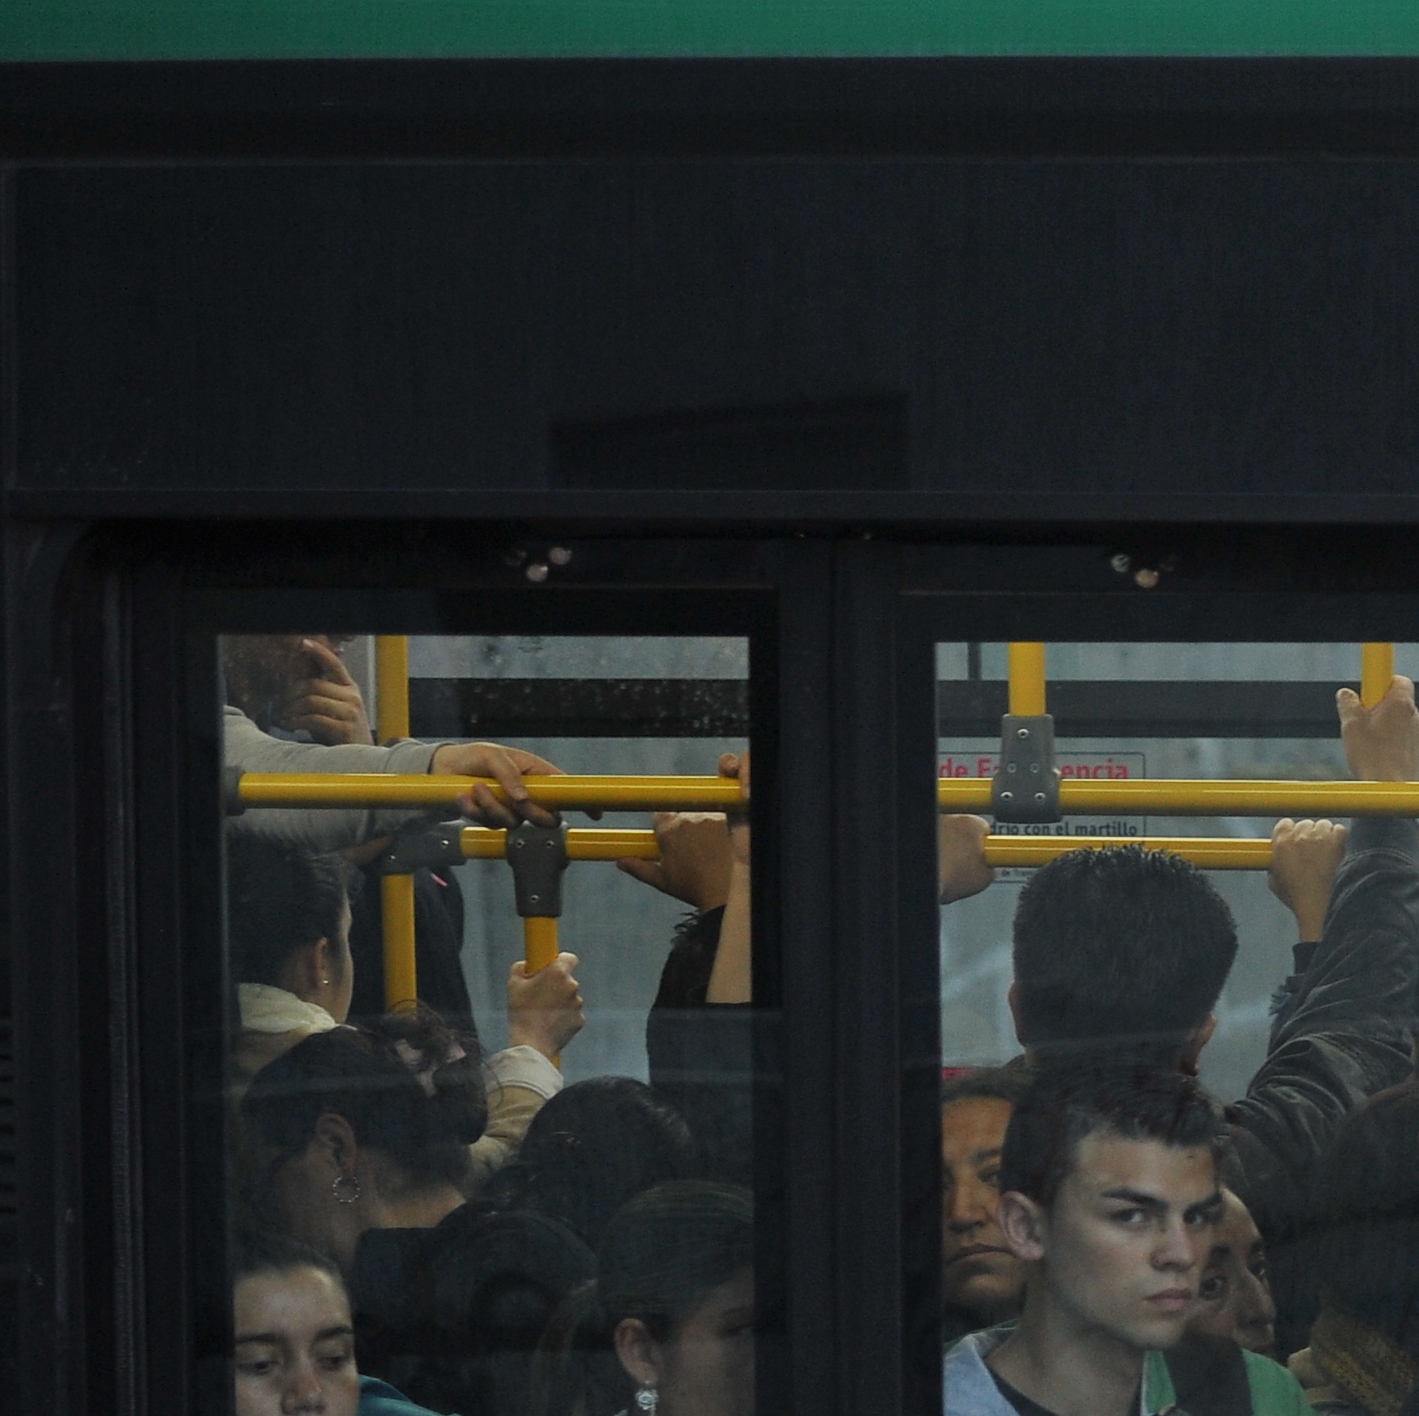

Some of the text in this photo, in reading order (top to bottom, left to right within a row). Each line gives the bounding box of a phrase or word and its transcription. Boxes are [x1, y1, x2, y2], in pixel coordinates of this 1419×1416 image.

[977, 758, 1129, 779] Eencia
[1024, 824, 1050, 836] con
[1055, 822, 1069, 835] el
[1075, 822, 1138, 836] martillo
